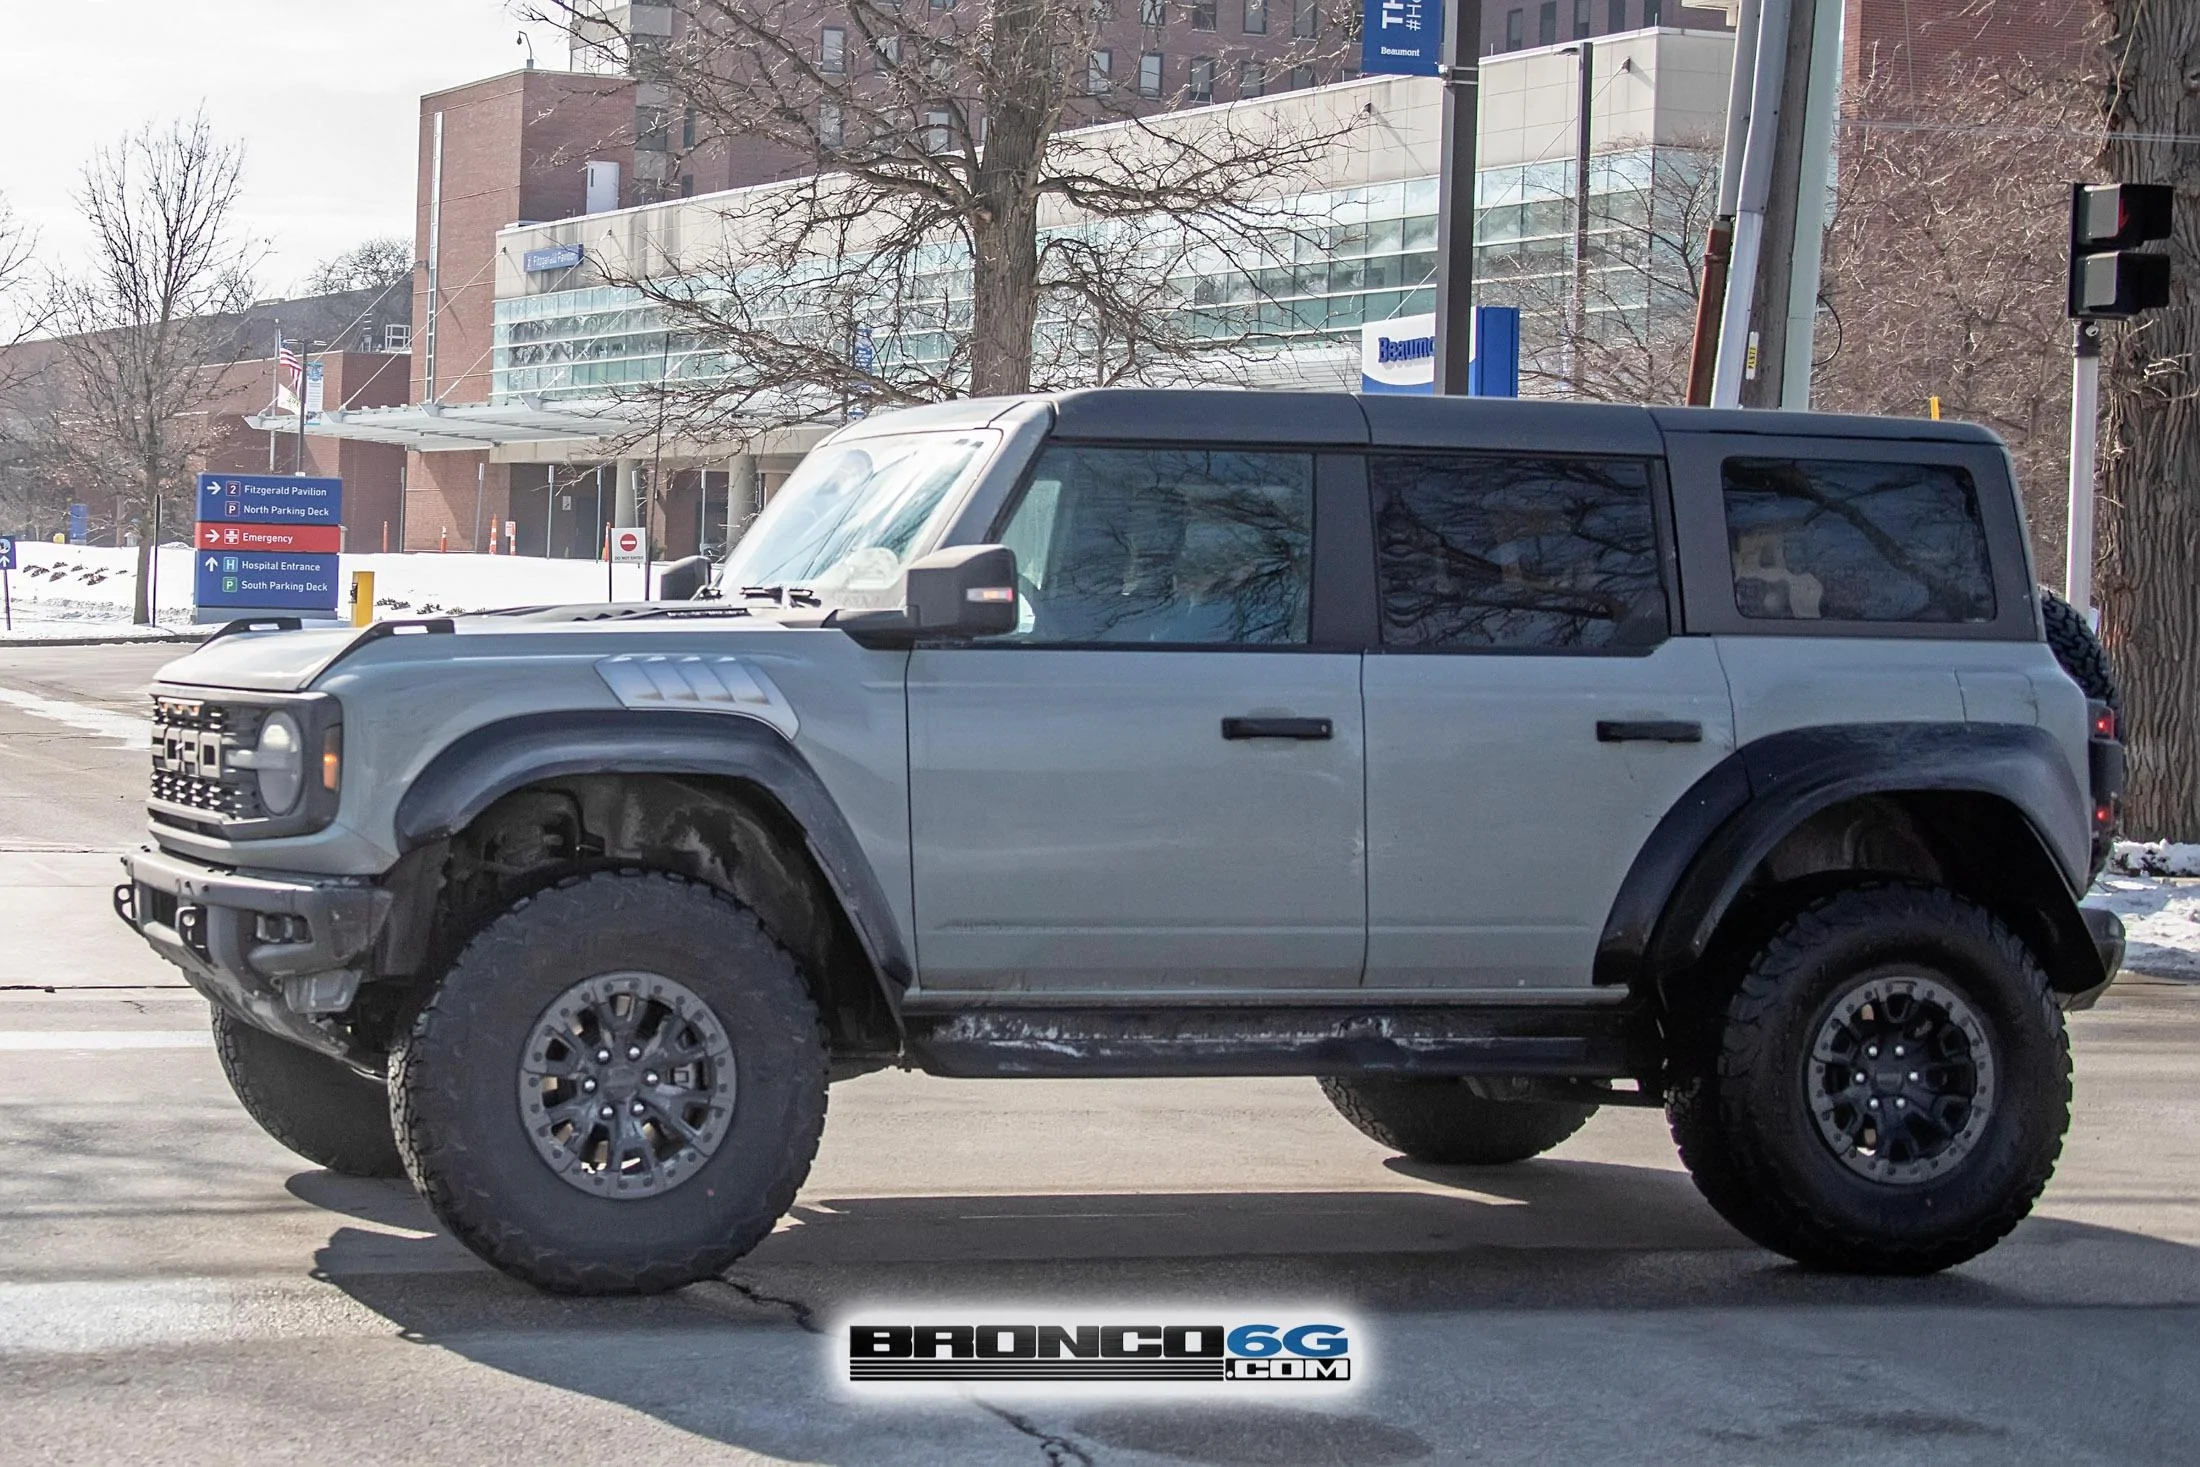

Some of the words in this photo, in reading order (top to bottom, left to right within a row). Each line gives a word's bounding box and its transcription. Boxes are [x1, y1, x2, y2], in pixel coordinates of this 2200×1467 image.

[1380, 46, 1420, 57] Beaumont
[230, 485, 236, 495] 2
[244, 485, 290, 496] Fitzgerald
[291, 486, 327, 497] Pavilion
[229, 505, 236, 514] P
[243, 505, 269, 515] North
[271, 507, 305, 517] Parking
[307, 507, 329, 517] Deck
[242, 532, 293, 544] Emergency
[226, 560, 235, 569] H
[241, 560, 279, 572] Hospital
[281, 561, 321, 572] Entrance
[226, 581, 233, 590] P
[241, 580, 267, 590] South
[269, 581, 304, 592] Parking
[306, 582, 328, 592] Deck
